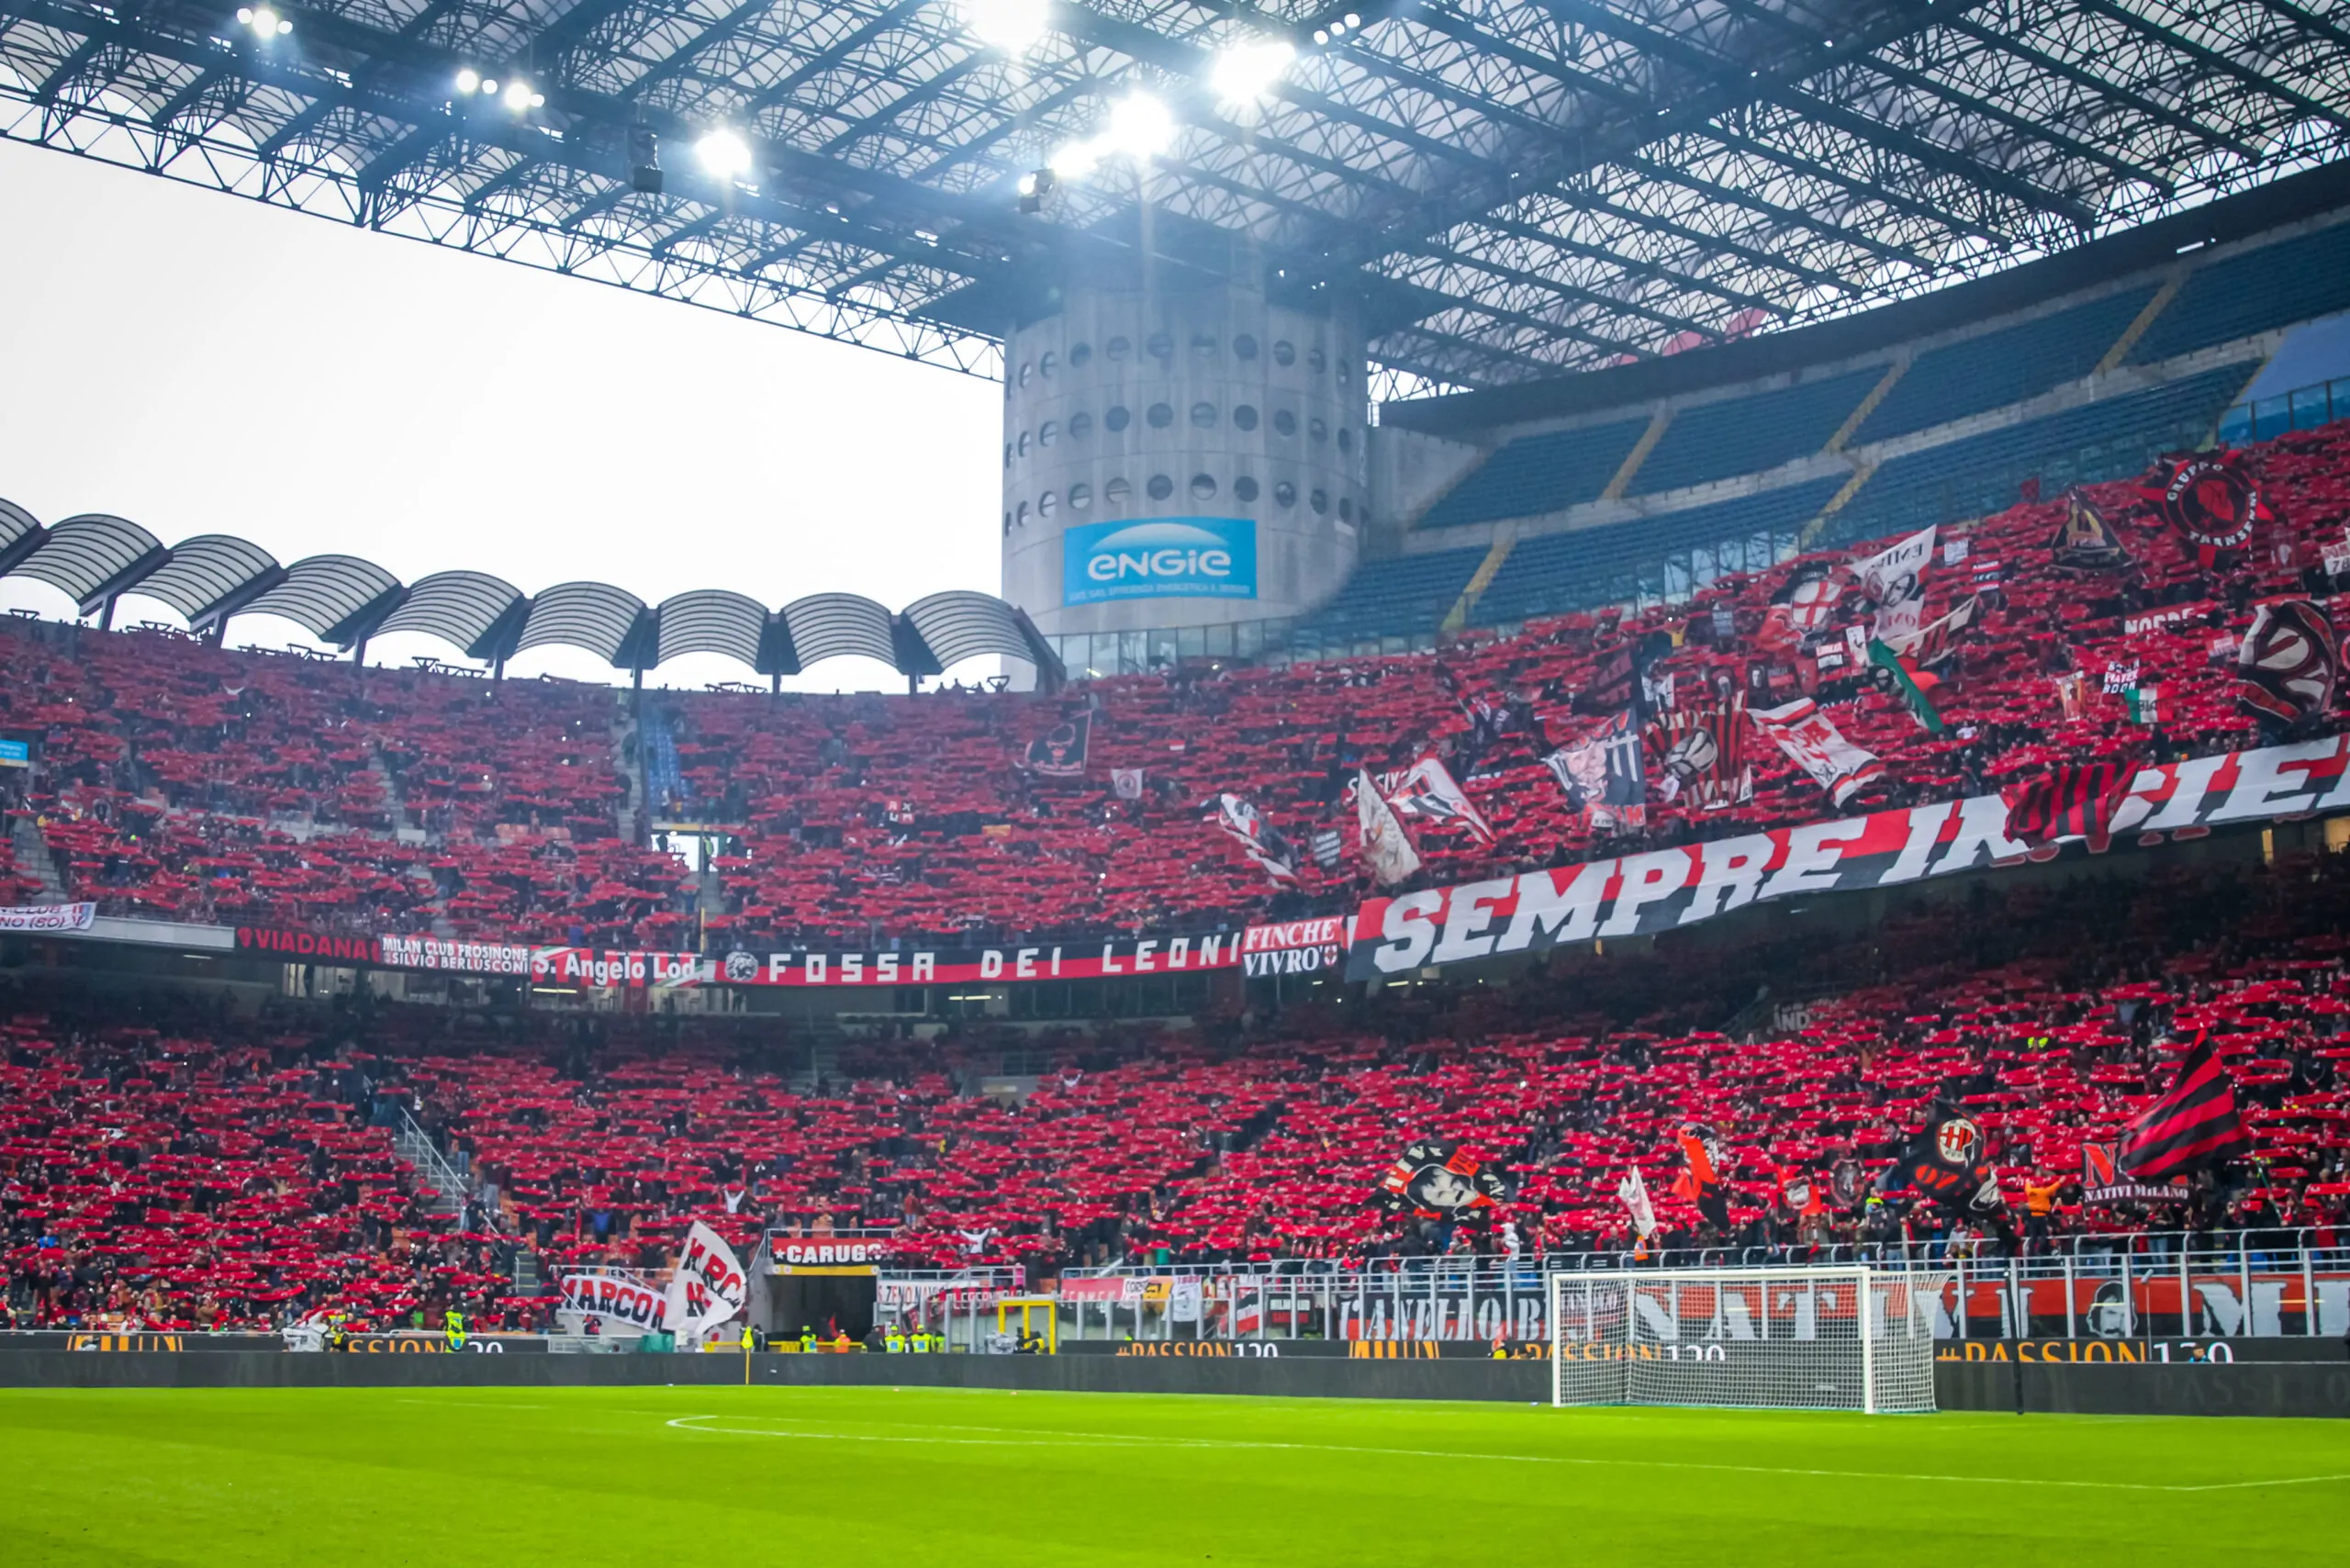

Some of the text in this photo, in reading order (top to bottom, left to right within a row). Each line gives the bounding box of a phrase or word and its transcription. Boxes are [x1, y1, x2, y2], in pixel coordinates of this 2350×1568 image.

[1372, 823, 1866, 975] SEMPRE
[254, 929, 367, 961] VIADANA
[383, 936, 529, 961] MILAN CLUB FROSINONE
[768, 931, 1241, 982] FOSSA DEI LEONI
[391, 950, 530, 974] SILVIO BERLUSCONI
[564, 952, 646, 986] Angelo
[2084, 1183, 2132, 1204] NATIVI
